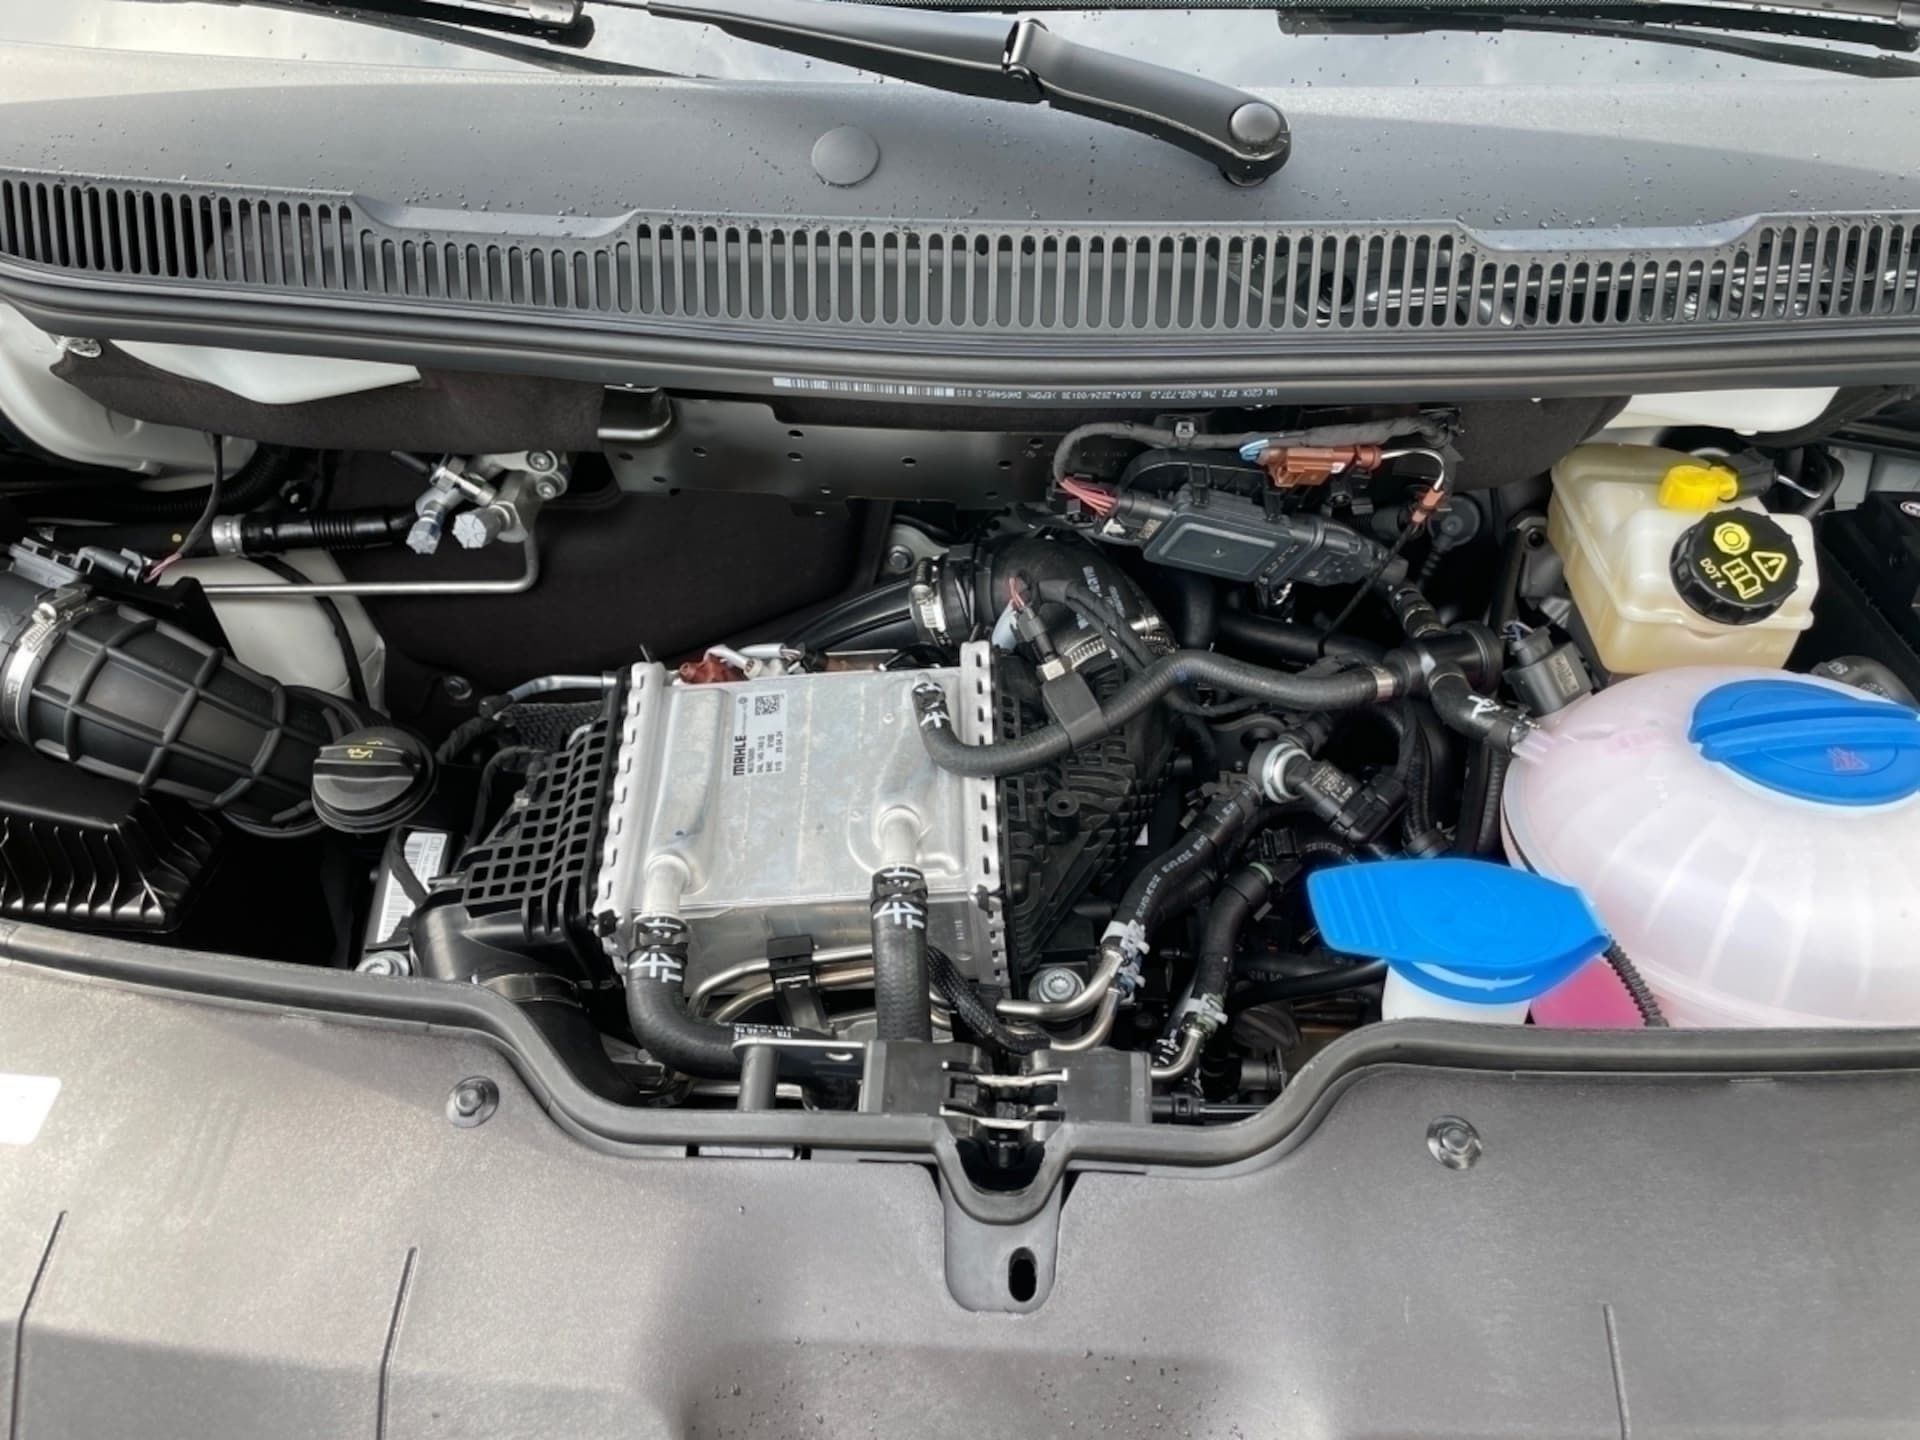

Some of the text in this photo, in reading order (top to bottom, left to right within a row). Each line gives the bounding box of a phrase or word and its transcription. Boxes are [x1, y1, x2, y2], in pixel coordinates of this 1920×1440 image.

[1700, 557, 1727, 589] DOT 4
[733, 735, 746, 776] MAHLE
